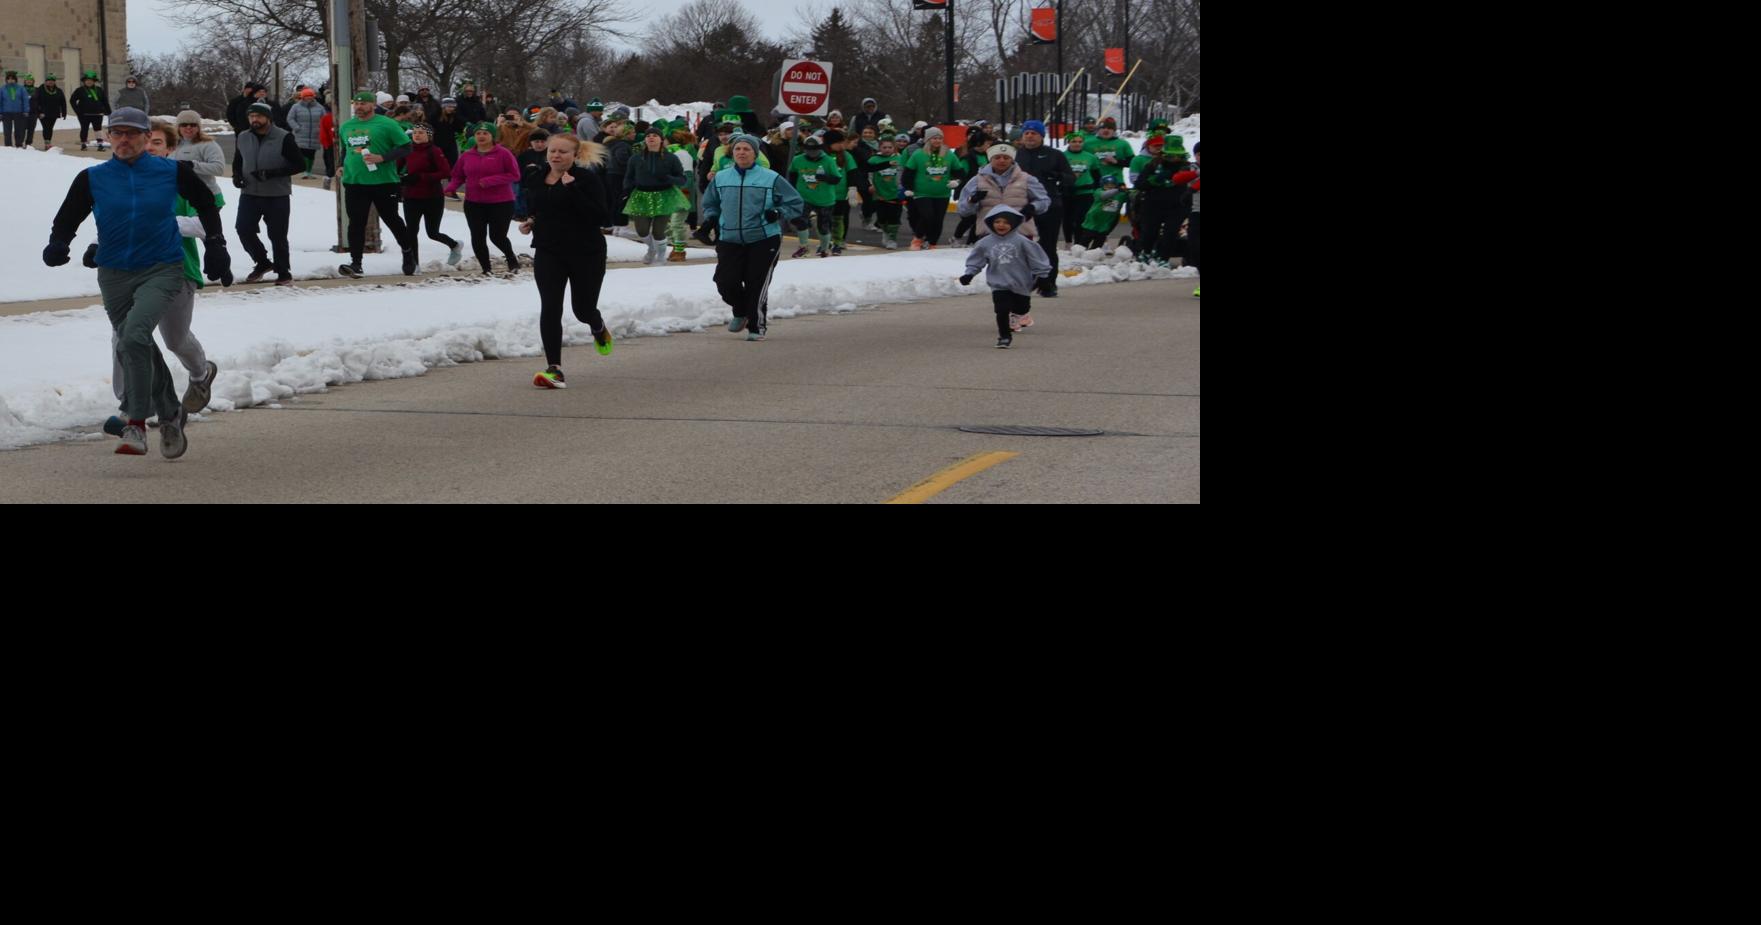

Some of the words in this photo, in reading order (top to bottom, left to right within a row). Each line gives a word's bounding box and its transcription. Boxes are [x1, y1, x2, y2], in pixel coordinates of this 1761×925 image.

[791, 71, 802, 80] DO
[805, 71, 822, 80] NOT
[790, 95, 817, 104] ENTER
